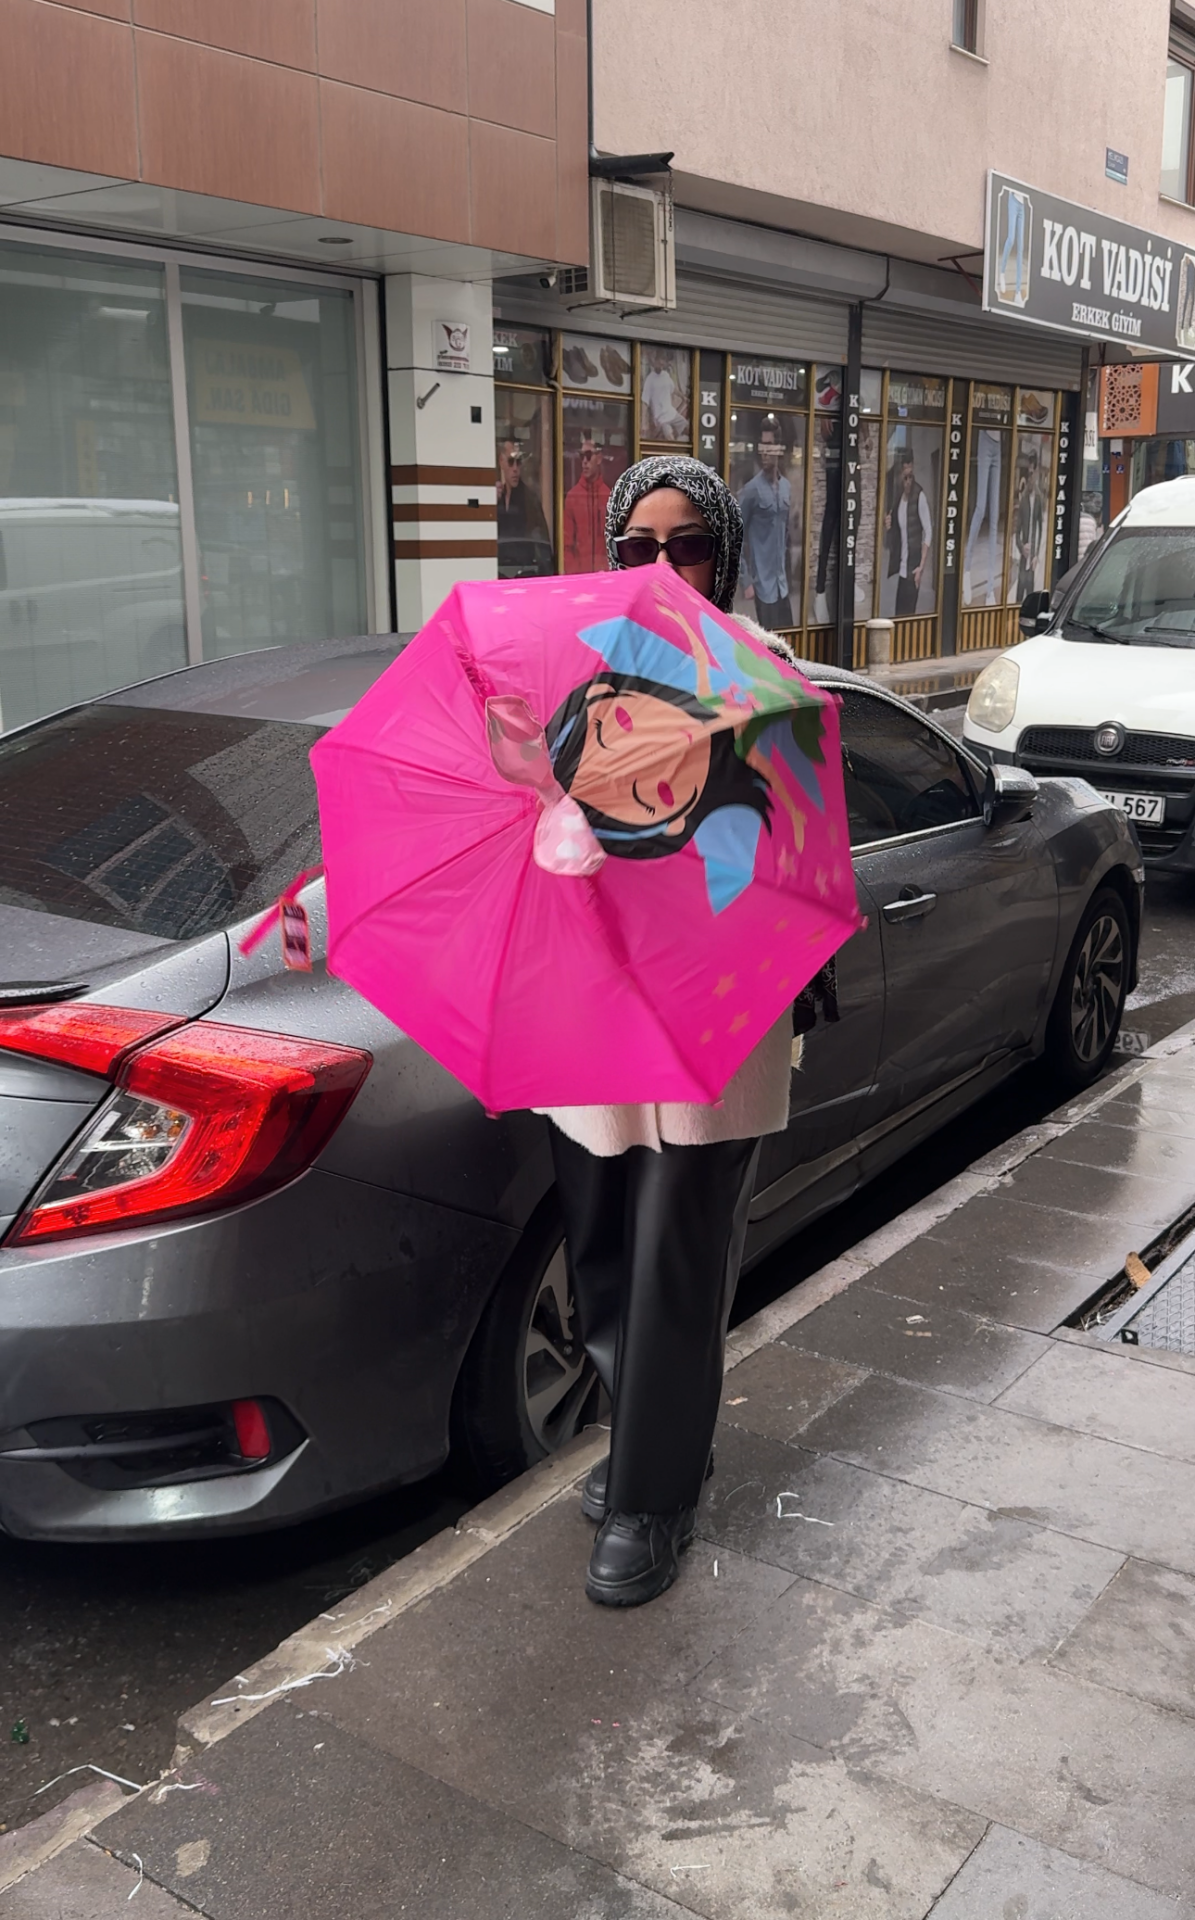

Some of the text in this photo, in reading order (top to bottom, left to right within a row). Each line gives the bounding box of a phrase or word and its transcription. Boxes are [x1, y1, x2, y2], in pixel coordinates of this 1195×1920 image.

[1040, 218, 1173, 312] KOT VADİSİ
[1071, 302, 1142, 337] ERKEK GİYİM
[737, 365, 760, 386] KOT
[701, 390, 717, 450] KOT
[846, 393, 859, 566] KOT VADİSİ
[945, 413, 962, 568] KOT VADİSİ
[1055, 421, 1070, 560] KOT VADİSİ
[1101, 735, 1116, 746] FIAT
[1123, 796, 1159, 818] 567
